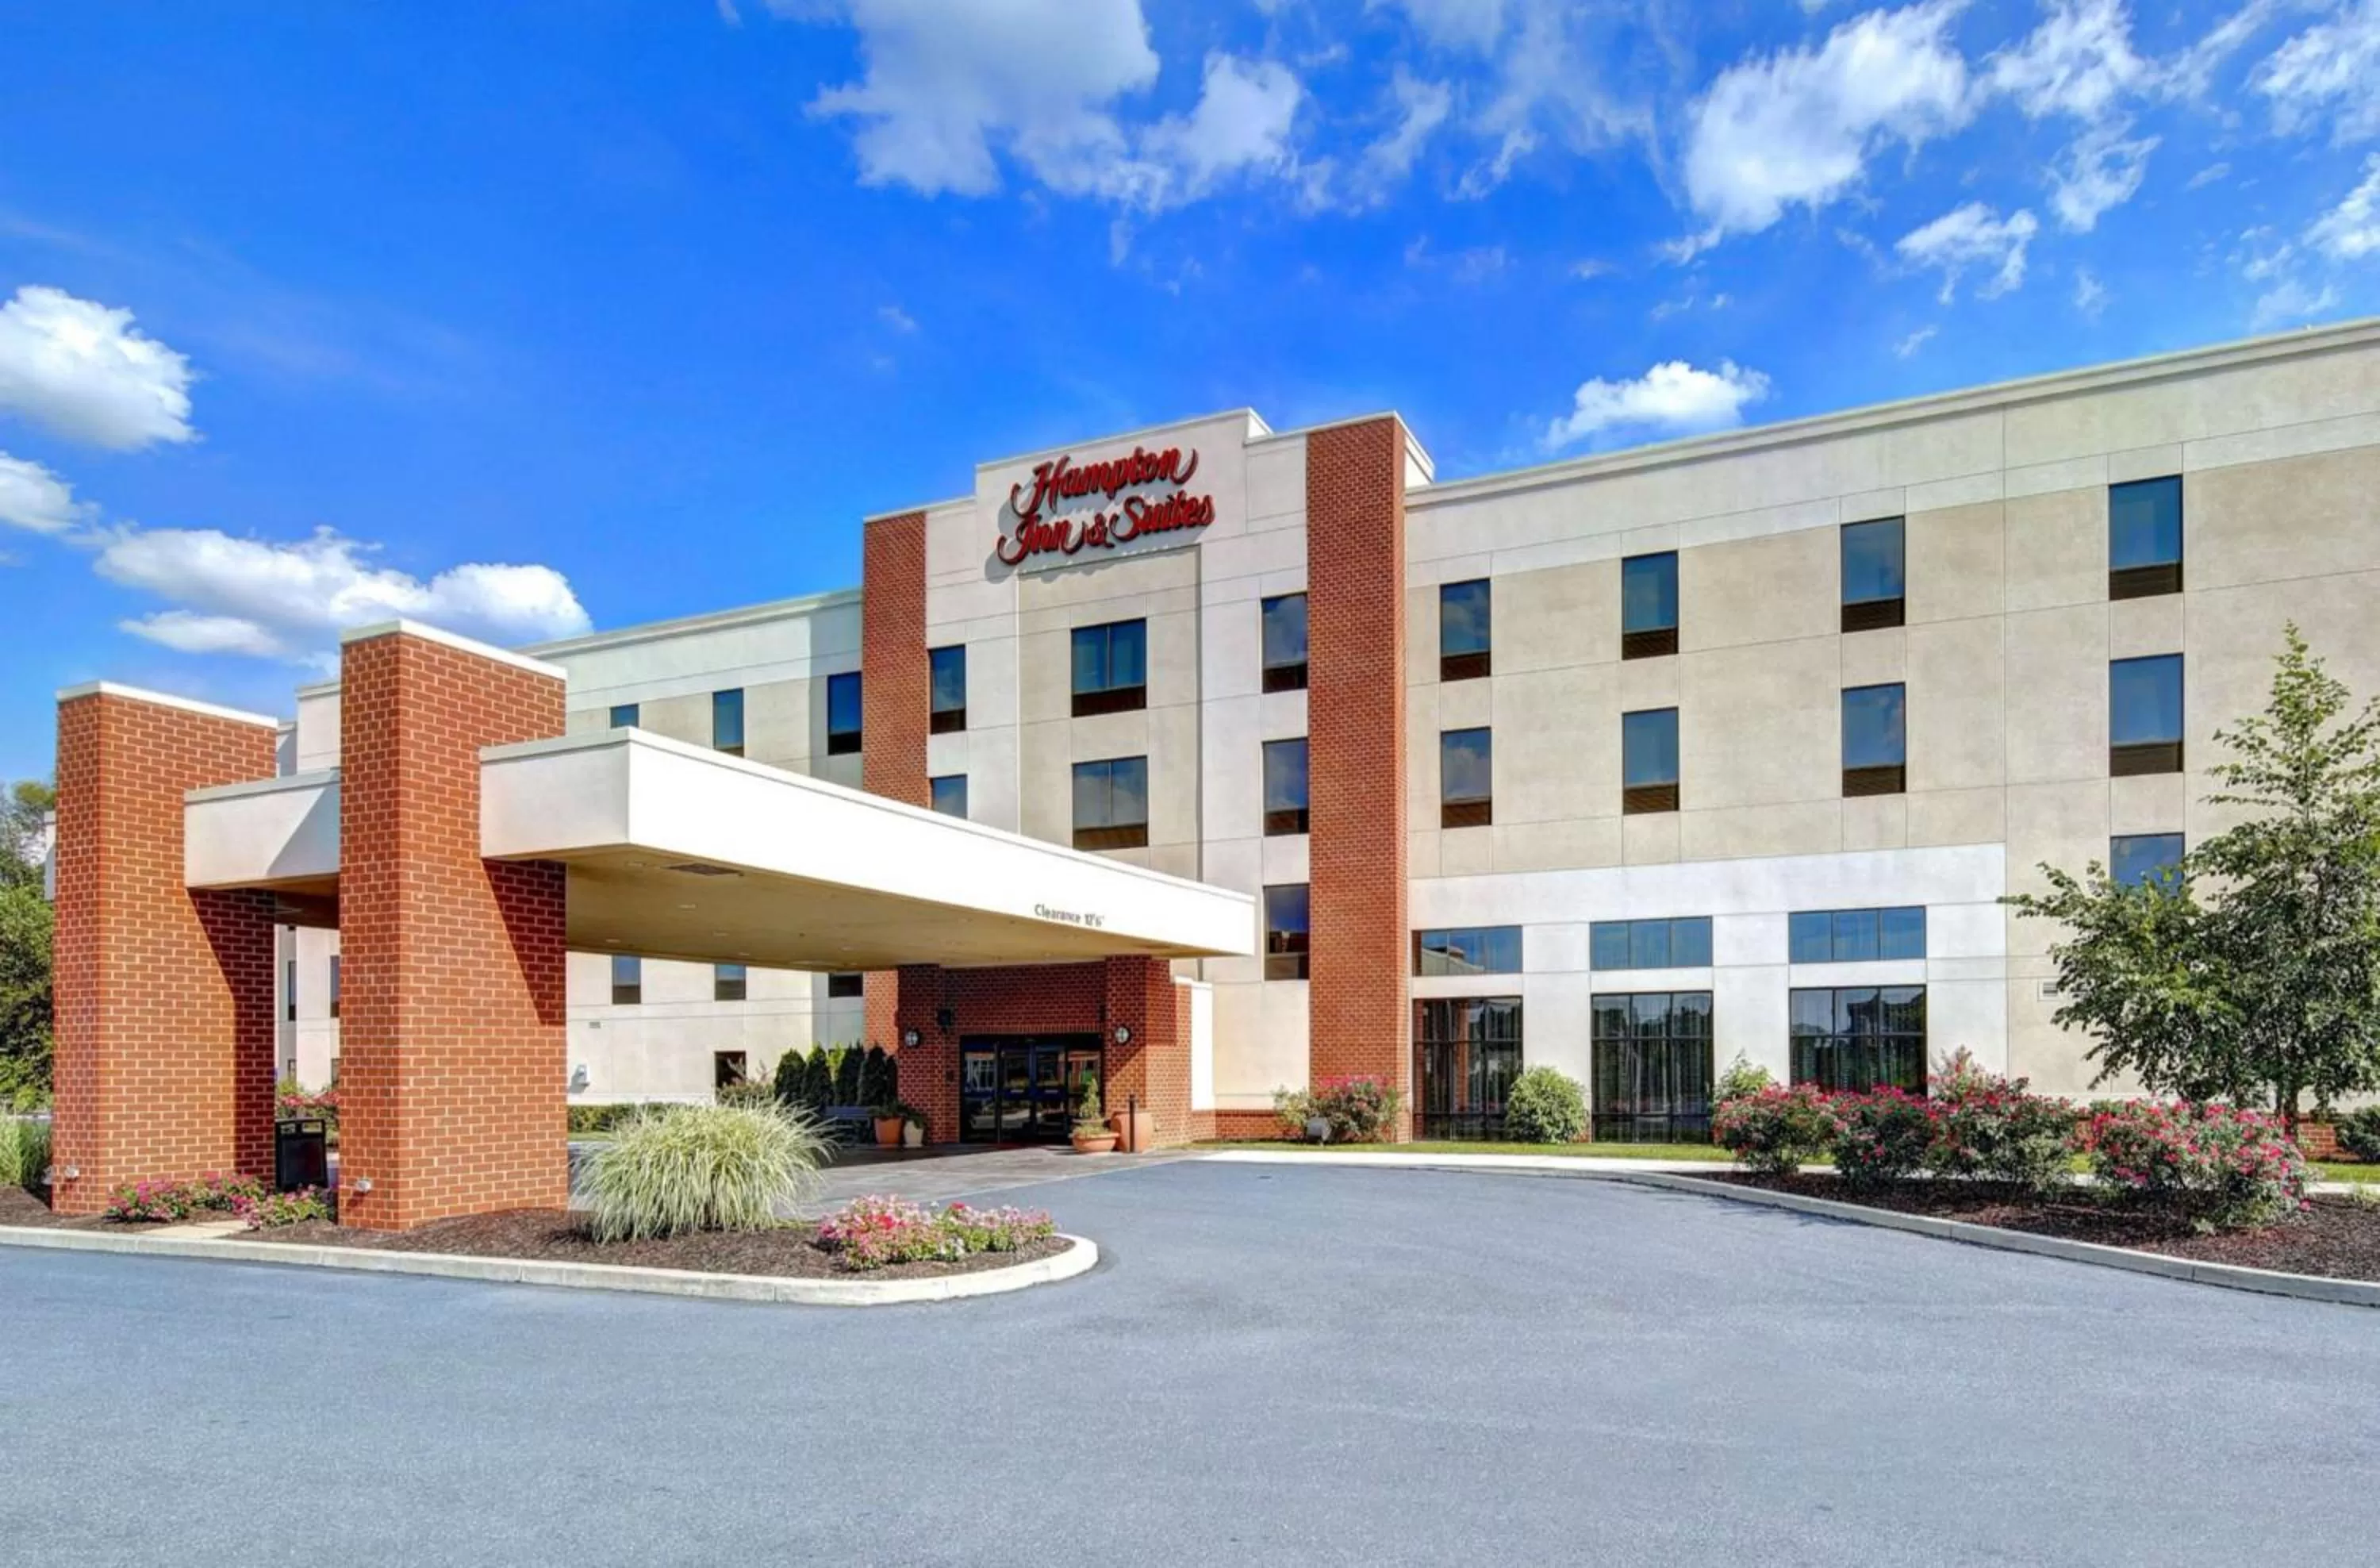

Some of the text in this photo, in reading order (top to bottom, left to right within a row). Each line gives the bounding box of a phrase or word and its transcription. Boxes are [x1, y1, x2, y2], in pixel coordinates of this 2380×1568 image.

[1011, 446, 1198, 517] Hampton
[997, 490, 1215, 565] Inn & Suites
[1035, 904, 1081, 923] Clearance
